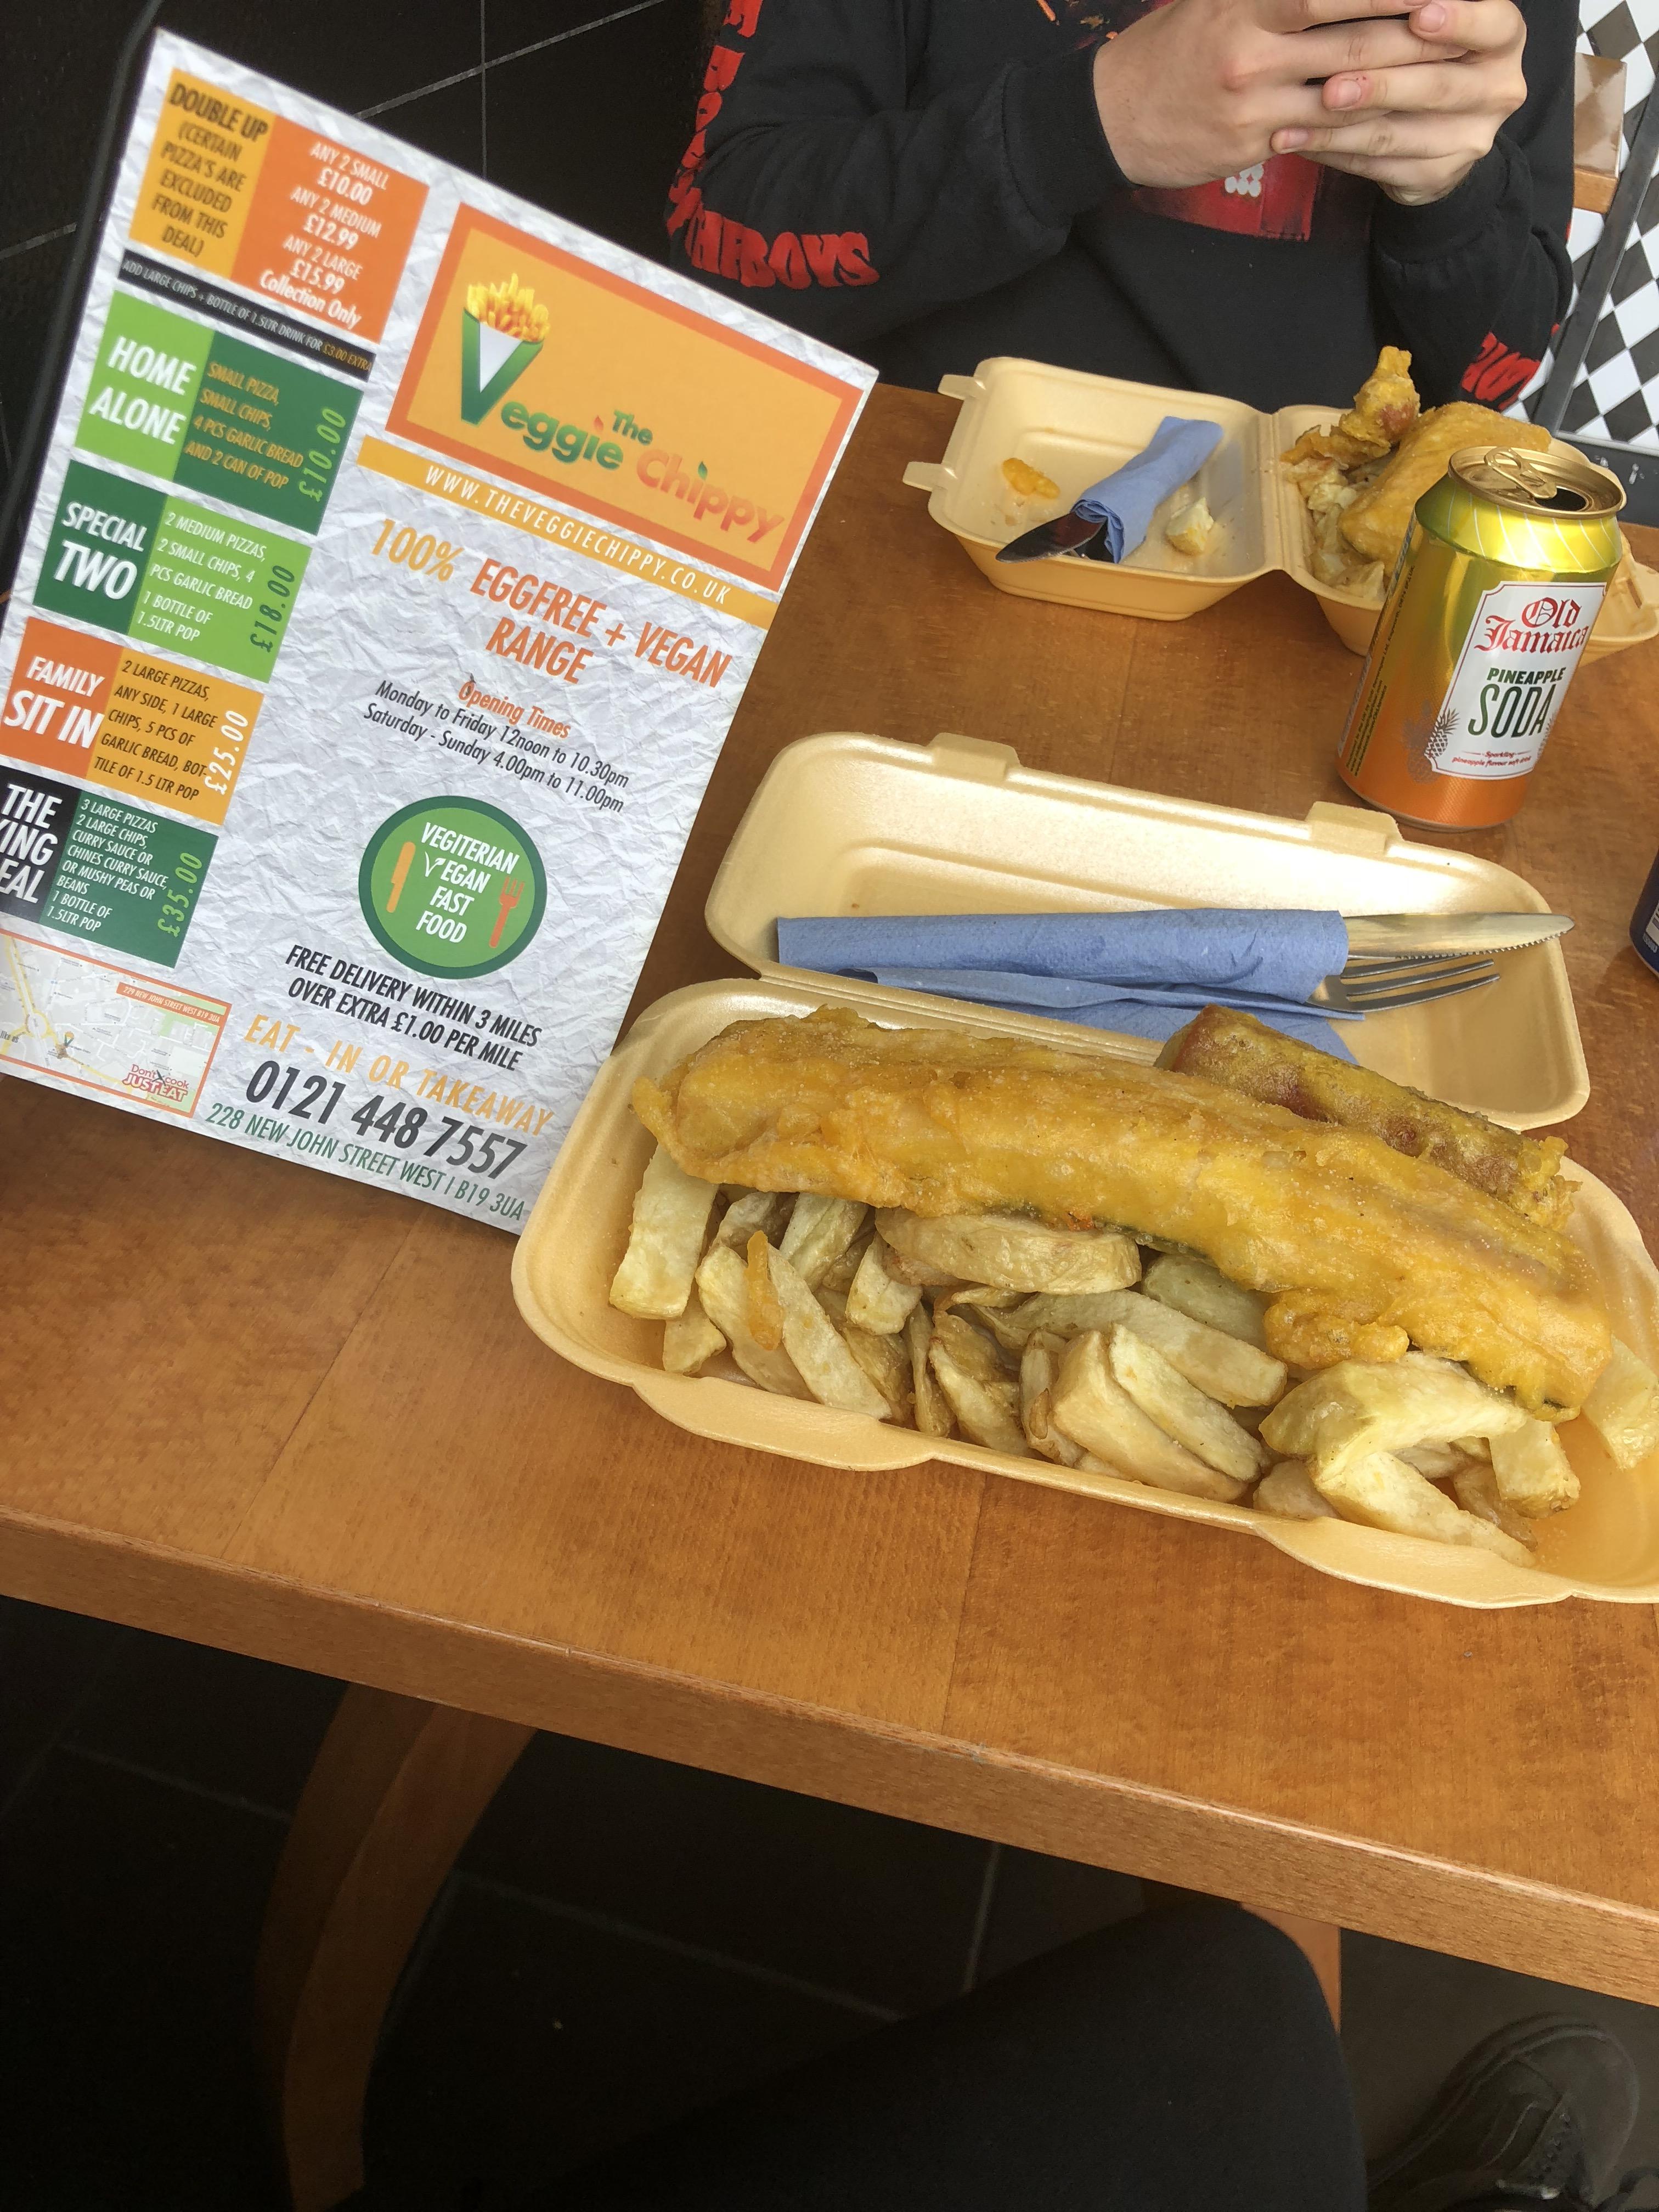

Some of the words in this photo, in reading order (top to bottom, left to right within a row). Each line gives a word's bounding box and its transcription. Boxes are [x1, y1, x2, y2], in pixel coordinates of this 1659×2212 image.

[170, 83, 243, 132] DOUBLE
[240, 115, 268, 142] UP
[178, 121, 242, 162] (CERTAIN
[161, 141, 216, 178] PIZZA'S
[216, 167, 247, 192] ARE
[309, 142, 340, 165] ANY
[350, 160, 390, 190] SMALL
[317, 167, 373, 205] £10.00
[160, 168, 232, 212] EXCLUDED
[290, 185, 320, 208] ANY
[330, 202, 382, 238] MEDIUM
[151, 193, 194, 224] FROM
[196, 211, 228, 239] THIS
[303, 213, 359, 250] £12.99
[161, 227, 205, 258] DEAL)
[283, 234, 312, 257] ANY
[323, 252, 363, 280] LARGE
[259, 269, 325, 312] Collection
[328, 298, 362, 329] Only
[290, 259, 345, 295] £15.99
[143, 268, 172, 288] LARGE
[172, 280, 198, 298] CHIPS
[206, 294, 238, 315] BOTTLE
[278, 321, 306, 344] DRINK
[347, 354, 373, 371] EXTRA
[108, 336, 197, 395] HOME
[207, 362, 245, 390] SMALL
[200, 388, 237, 415] SMALL
[461, 308, 624, 471] Veggie
[88, 387, 187, 444] ALONE
[613, 409, 653, 445] The
[184, 441, 212, 460] AND
[223, 455, 249, 474] CAN
[263, 471, 289, 489] POP
[226, 428, 268, 454] GARLIC
[266, 443, 303, 467] BREAD
[298, 409, 346, 503] £10.00
[636, 449, 785, 543] Chippy
[62, 502, 147, 552] SPECIAL
[176, 516, 225, 544] MEDIUM
[226, 534, 267, 562] PIZZAS,
[425, 465, 731, 604] WWW.THEVEGGIECHIPPY.CO.UK
[55, 540, 138, 599] TWO
[168, 542, 205, 566] SMALL
[207, 556, 241, 581] CHIPS,
[150, 564, 173, 582] PCS
[173, 572, 216, 597] GARLIC
[215, 587, 253, 610] BREAD
[153, 595, 195, 619] BOTTLE
[195, 610, 213, 624] OF
[250, 565, 295, 653] £18.00
[372, 517, 465, 582] 100%
[470, 558, 607, 637] EGGFREE
[635, 621, 732, 688] VEGAN
[137, 612, 175, 634] 1.5LTR
[176, 624, 200, 641] POP
[1474, 615, 1589, 653] Jamaica
[1521, 597, 1582, 628] Old
[485, 616, 595, 685] RANGE
[27, 656, 105, 697] FAMILY
[133, 664, 170, 686] LARGE
[171, 676, 210, 701] PIZZAS,
[1487, 667, 1566, 685] PINEAPPLE
[4, 690, 65, 735] SIT
[58, 706, 105, 748] IN
[108, 709, 142, 732] CHIPS,
[156, 724, 178, 741] PCS
[179, 733, 196, 747] OF
[114, 685, 140, 701] ANY
[140, 692, 168, 714] SIDE,
[182, 707, 218, 728] LARGE
[458, 680, 524, 725] Opening
[527, 706, 571, 738] Times
[1468, 684, 1556, 738] SODA
[101, 733, 142, 755] GARLIC
[142, 747, 178, 771] BREAD,
[183, 760, 207, 777] BOT-
[205, 710, 249, 795] £25.00
[375, 680, 434, 716] Monday
[435, 704, 450, 720] to
[452, 708, 498, 740] Friday
[500, 726, 550, 758] 12noon
[552, 748, 567, 764] to
[571, 752, 629, 788] 10.30pm
[94, 757, 119, 774] TILE
[119, 765, 136, 779] OF
[136, 770, 155, 786] 1.5
[155, 777, 176, 793] LTR
[176, 785, 199, 800] POP
[364, 703, 428, 741] Saturday
[439, 730, 491, 764] Sunday
[493, 751, 545, 781] 4.00pm
[547, 772, 561, 788] to
[566, 777, 624, 812] 11.00pm
[1, 783, 63, 829] THE
[90, 800, 125, 822] LARGE
[125, 813, 158, 834] PIZZAS
[72, 830, 105, 850] CURRY
[106, 840, 138, 860] SAUCE
[138, 852, 153, 866] OR
[86, 817, 117, 838] LARGE
[119, 828, 148, 849] CHIPS,
[421, 822, 520, 874] VEGITERIAN
[57, 875, 90, 895] BEANS
[67, 844, 103, 866] CHINES
[104, 857, 136, 877] CURRY
[137, 868, 170, 890] SAUCE,
[79, 865, 115, 887] MUSHY
[115, 877, 139, 895] PEAS
[140, 887, 156, 900] OR
[61, 893, 95, 912] BOTTLE
[157, 853, 202, 938] £35.00
[430, 885, 475, 916] FAST
[47, 906, 79, 926] 1.5LTR
[80, 916, 101, 932] POP
[416, 910, 467, 943] FOOD
[136, 990, 149, 999] NEW
[148, 994, 163, 1005] JOHN
[163, 1000, 183, 1011] STREET
[285, 945, 332, 976] FREE
[330, 959, 413, 1002] DELIVERY
[411, 986, 477, 1025] WITHIN
[489, 1014, 542, 1047] MILES
[288, 977, 336, 1008] OVER
[336, 993, 391, 1028] EXTRA
[391, 1012, 445, 1044] £1.00
[444, 1029, 479, 1057] PER
[478, 1041, 523, 1071] MILE
[122, 1073, 161, 1094] JUST
[164, 1077, 190, 1090] cook
[244, 1014, 301, 1053] EAT
[325, 1040, 363, 1073] IN
[368, 1055, 410, 1089] OR
[416, 1069, 554, 1137] TAKEAWAY
[246, 1060, 346, 1125] 0121
[351, 1095, 428, 1149] 448
[423, 1116, 528, 1180] 7557
[205, 1103, 245, 1130] 228
[244, 1114, 290, 1143] NEW
[287, 1128, 339, 1159] JOHN
[338, 1143, 400, 1176] STREET
[400, 1161, 447, 1191] WEST
[454, 1180, 490, 1206] B19
[489, 1193, 525, 1221] 3UA
